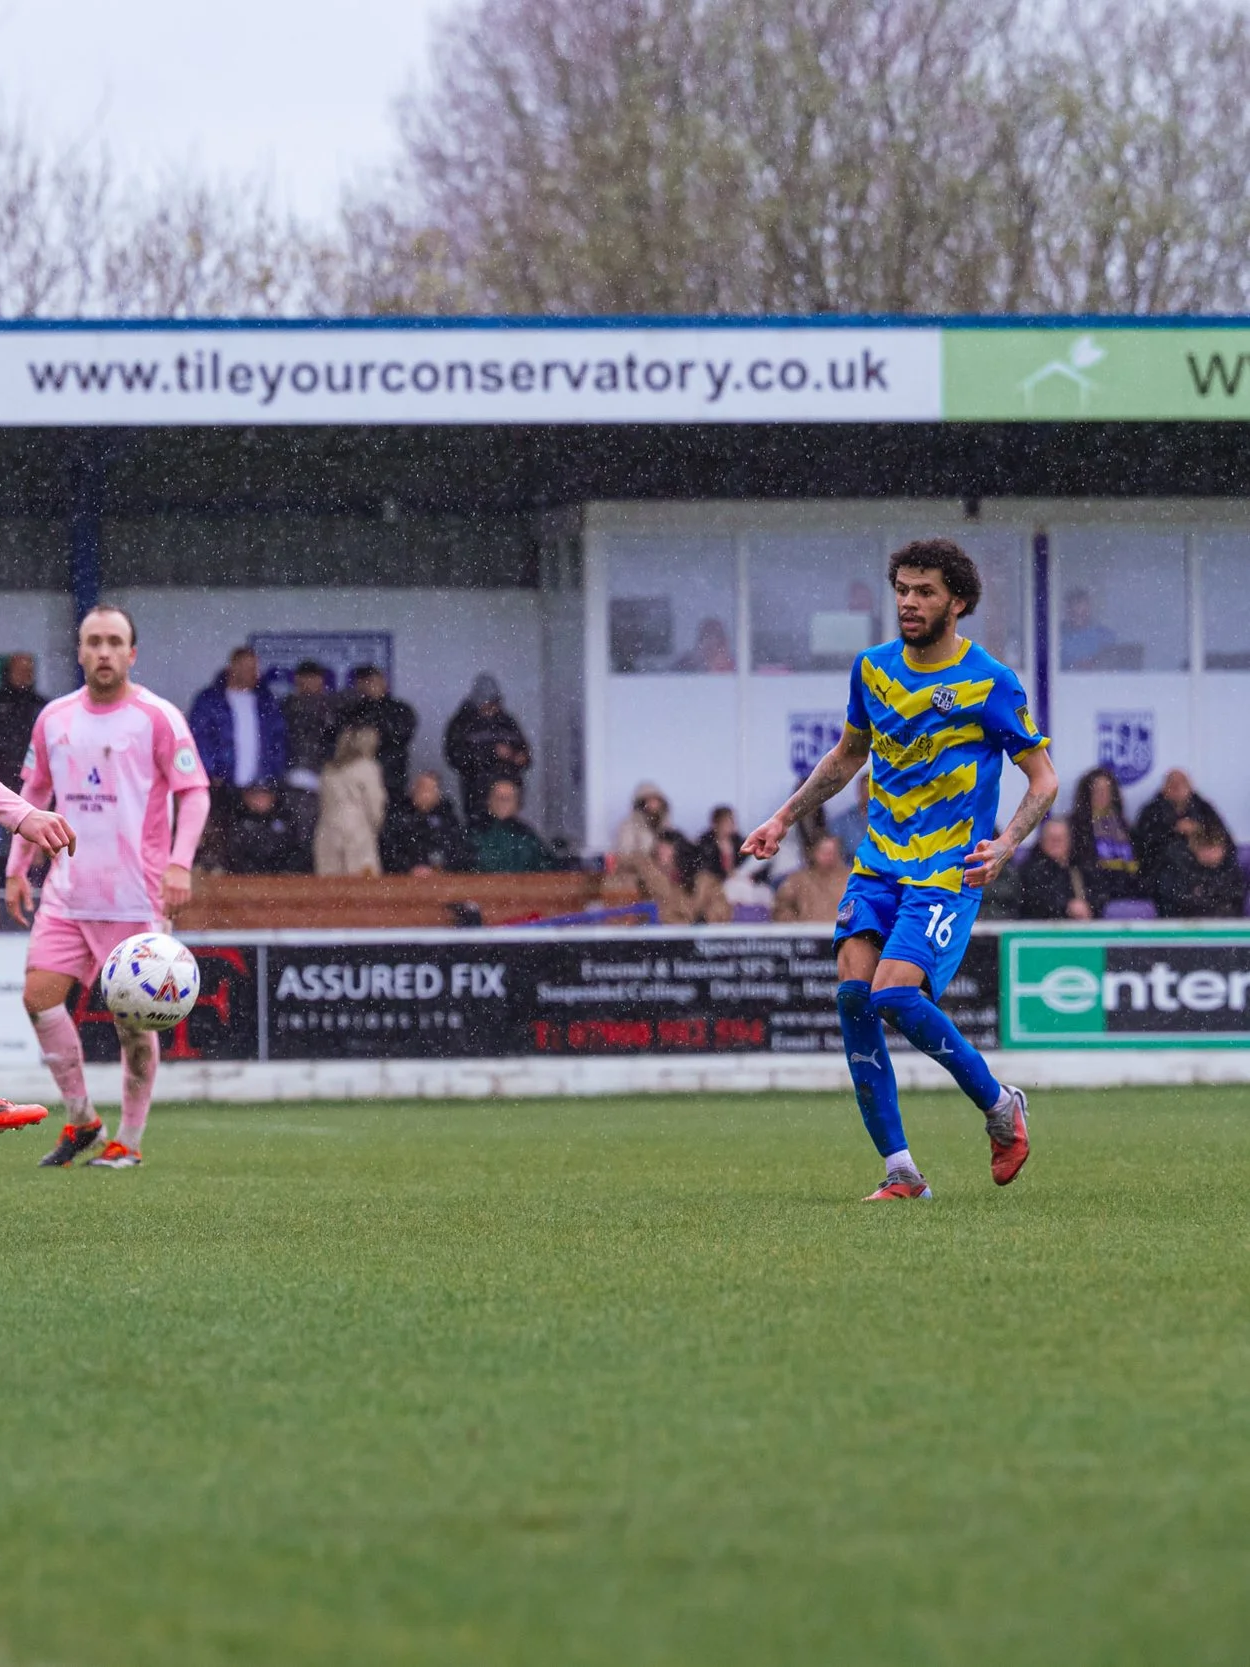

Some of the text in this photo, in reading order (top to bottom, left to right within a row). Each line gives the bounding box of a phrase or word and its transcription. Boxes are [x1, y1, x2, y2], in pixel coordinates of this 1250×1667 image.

[28, 348, 890, 404] www.tileyourconservatory.co.uk
[877, 732, 934, 757] MANTER
[924, 903, 957, 947] 16
[276, 962, 508, 1000] ASSURED FIX
